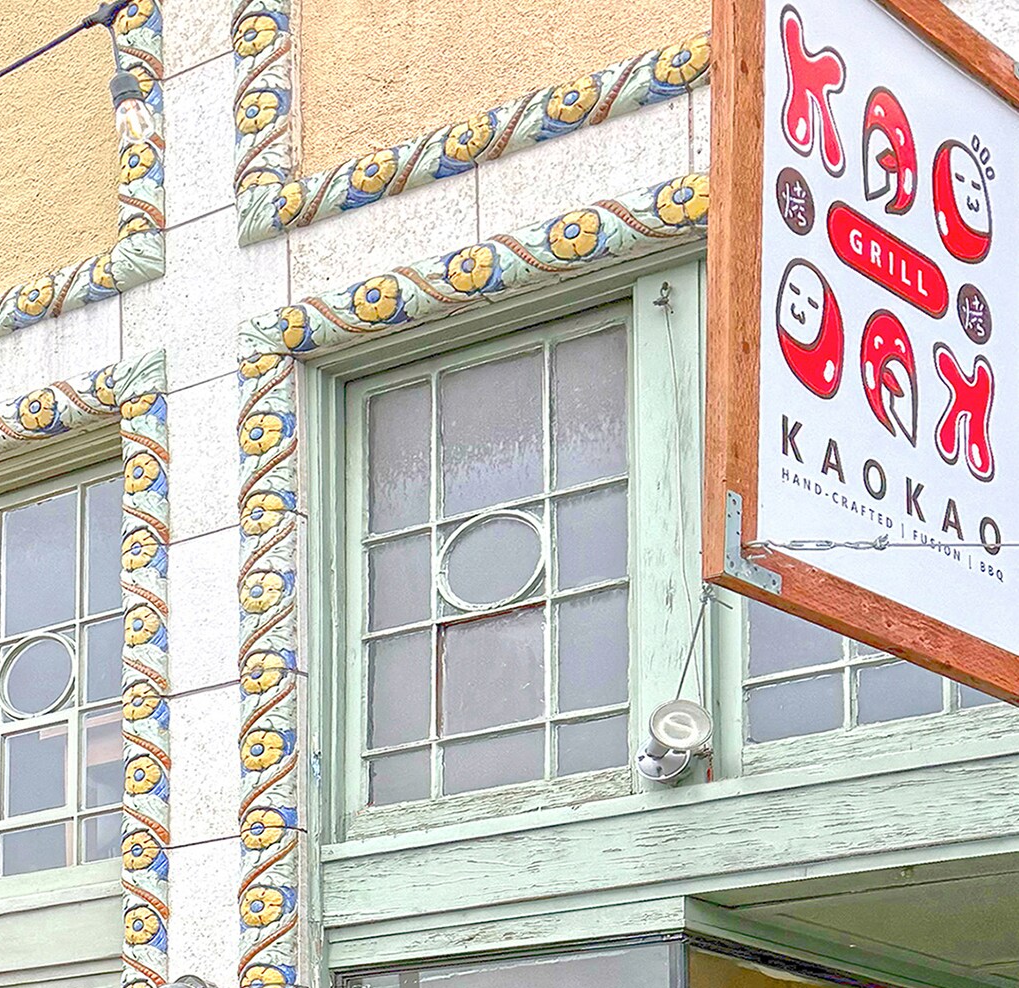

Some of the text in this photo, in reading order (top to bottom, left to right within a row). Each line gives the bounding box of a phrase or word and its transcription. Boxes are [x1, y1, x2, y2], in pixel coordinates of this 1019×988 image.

[849, 229, 928, 297] GRILL
[781, 414, 1001, 556] KAOKAO
[781, 467, 1004, 583] HAND-CRAFTED FUSION BBQ
